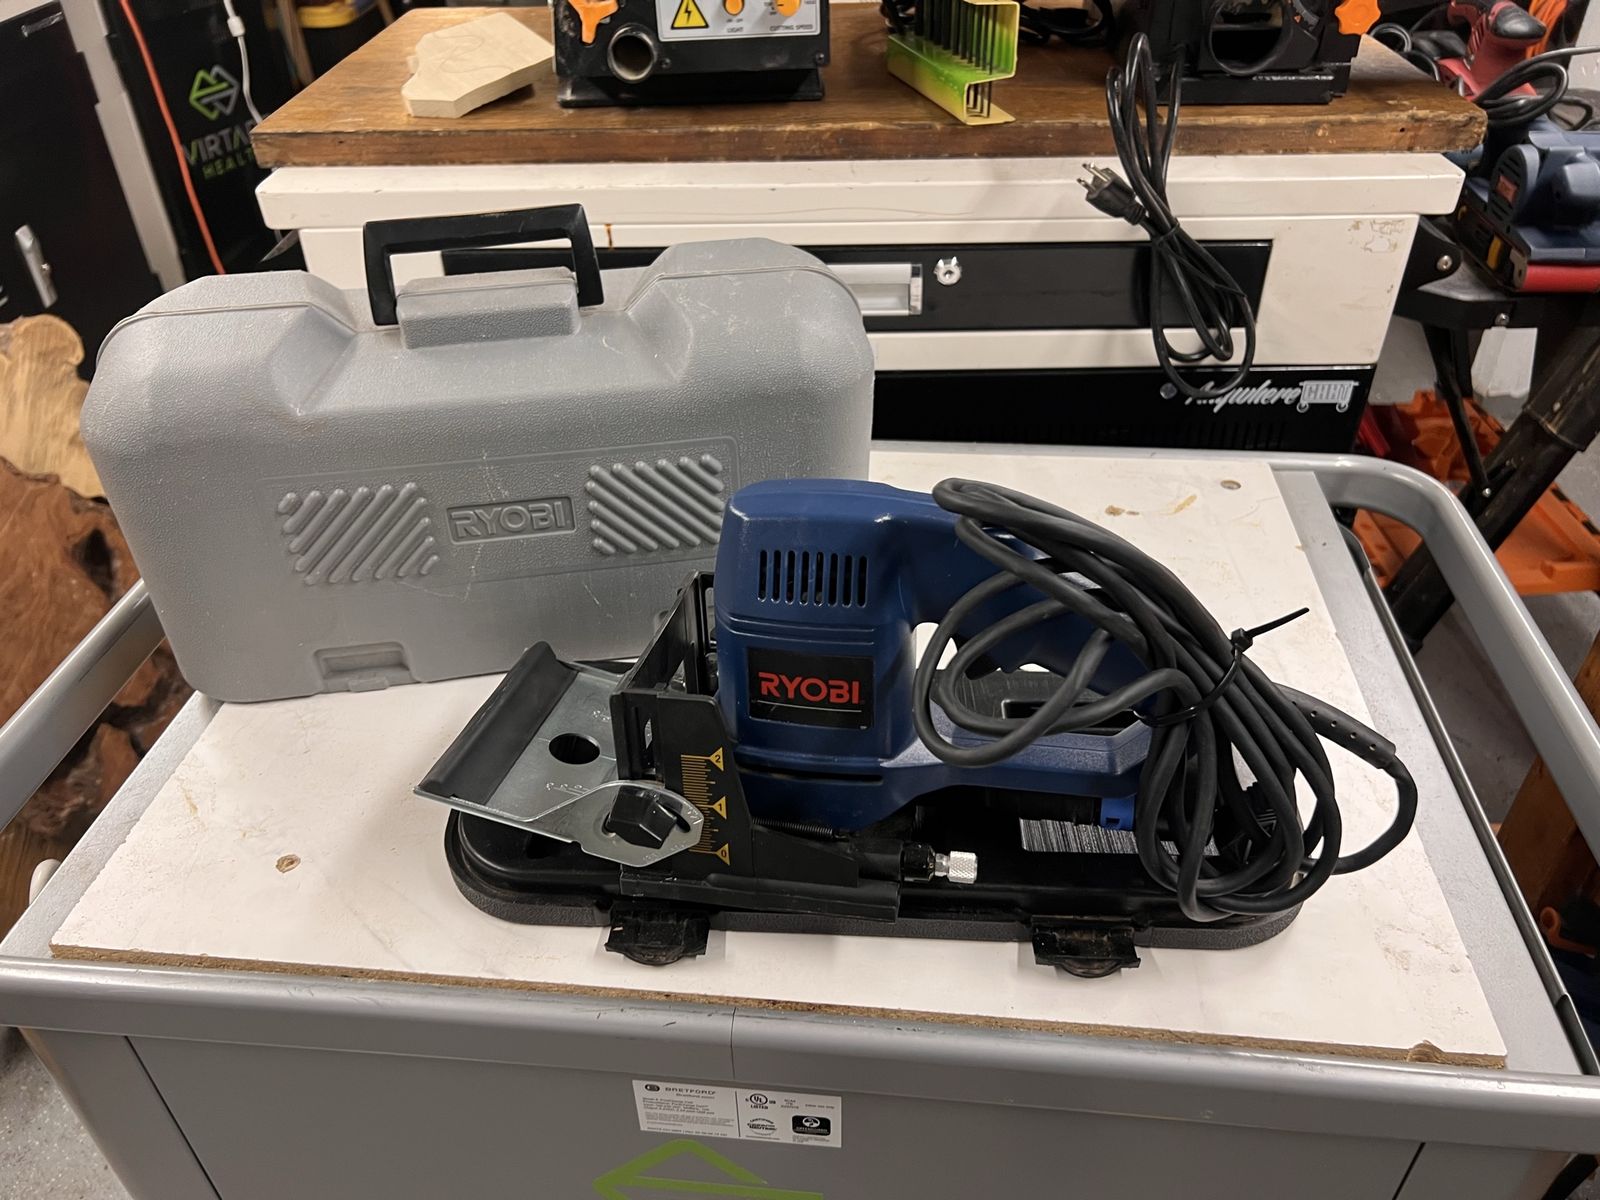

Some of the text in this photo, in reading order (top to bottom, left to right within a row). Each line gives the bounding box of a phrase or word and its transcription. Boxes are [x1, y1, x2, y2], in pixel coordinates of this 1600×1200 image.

[183, 118, 257, 165] VIRTA
[451, 501, 566, 538] RYOBI
[758, 671, 860, 704] RYOBI
[715, 754, 721, 763] 2
[720, 849, 727, 858] 0
